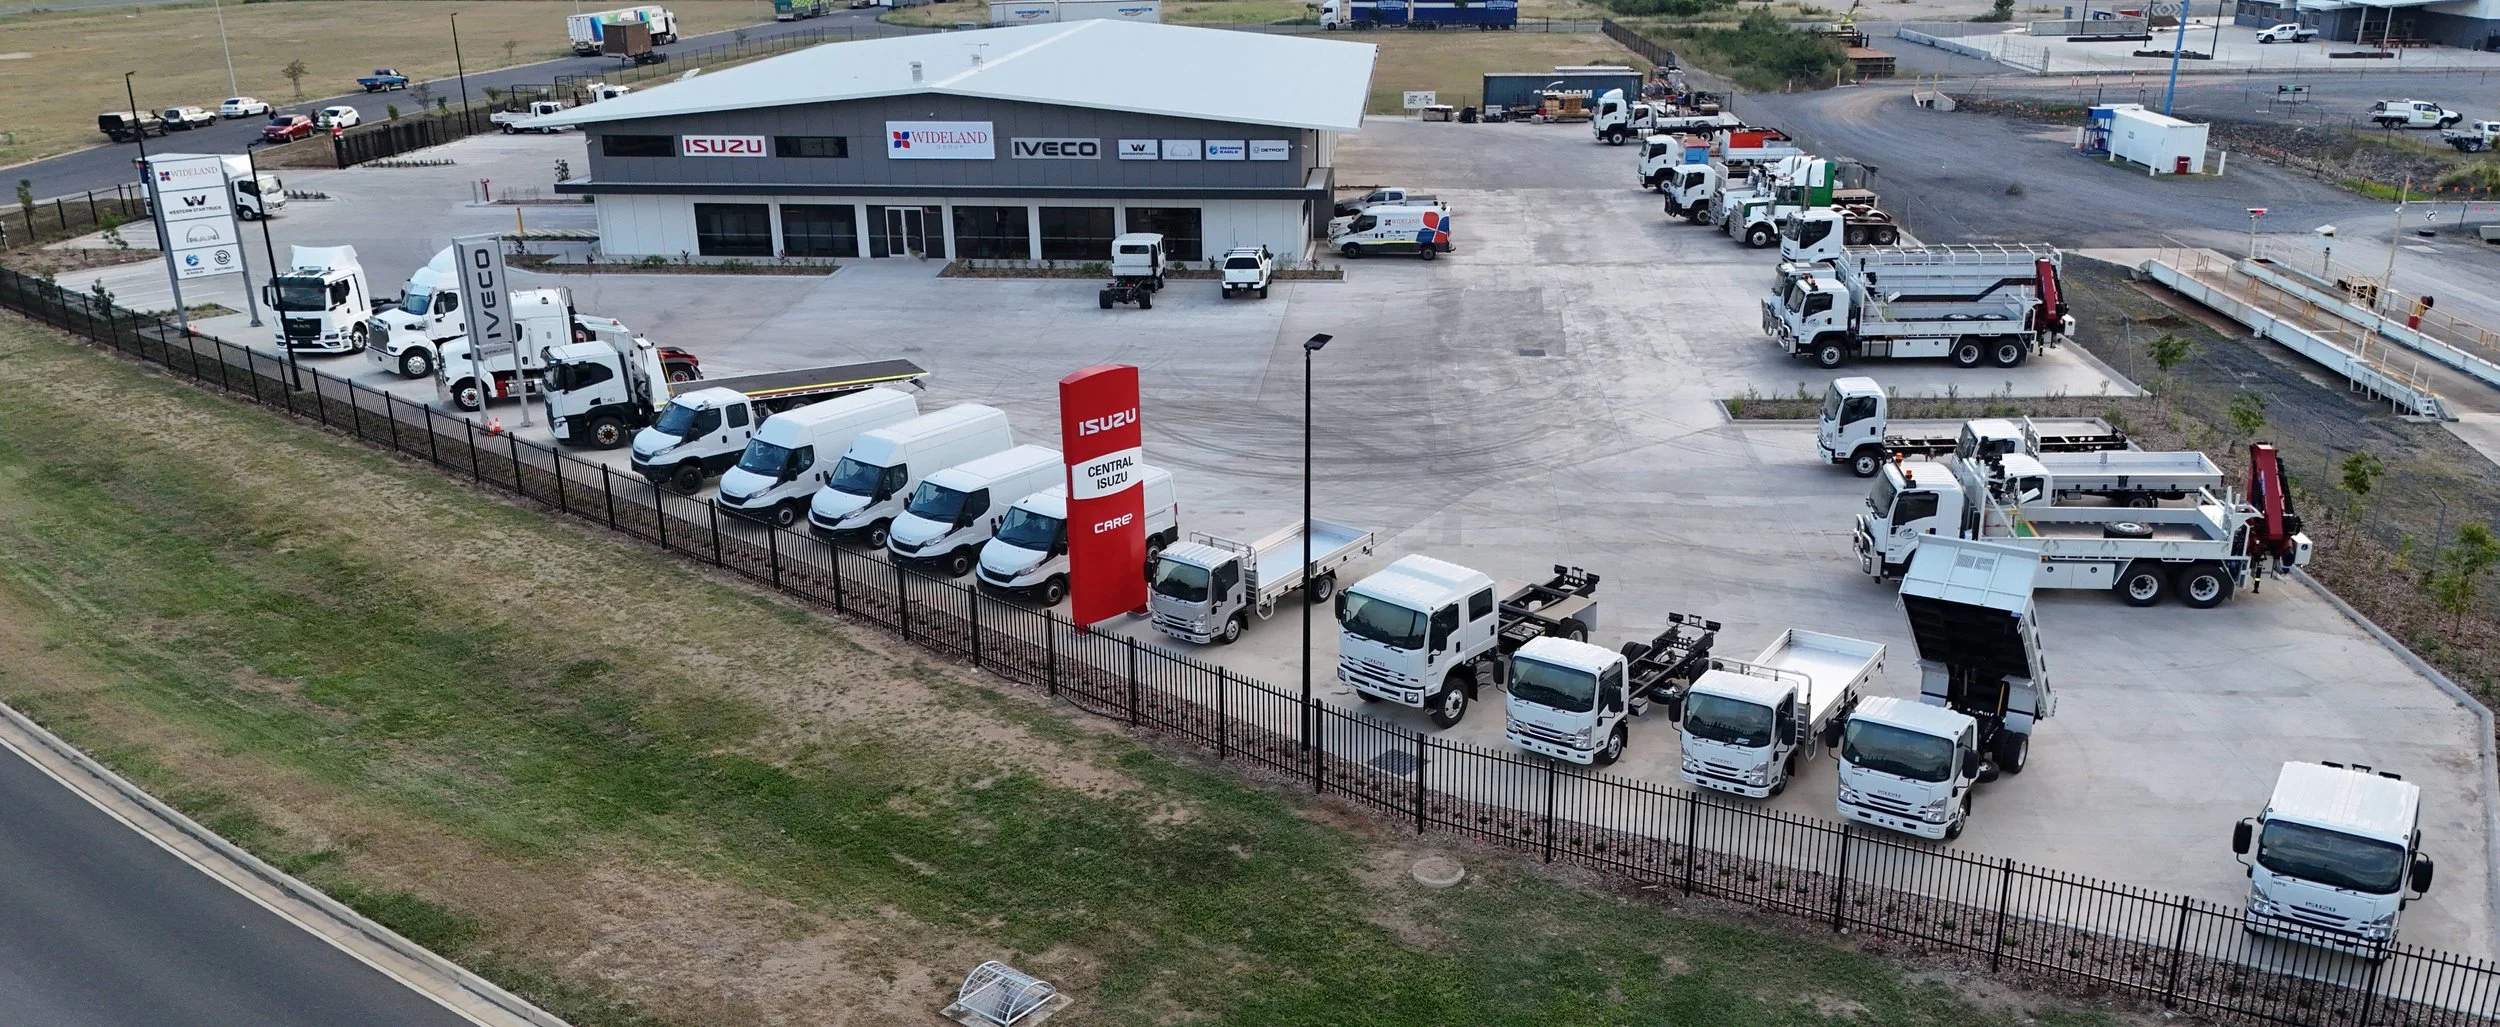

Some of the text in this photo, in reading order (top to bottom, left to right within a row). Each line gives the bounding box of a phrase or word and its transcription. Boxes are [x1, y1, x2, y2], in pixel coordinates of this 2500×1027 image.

[910, 130, 987, 145] WIDELAND
[686, 139, 762, 154] ISUZU
[1014, 141, 1097, 157] IVECO
[170, 166, 218, 177] WIDELAND
[474, 248, 502, 340] IVECO
[1078, 407, 1137, 437] ISUZU
[1087, 455, 1134, 478] CENTRAL
[1096, 470, 1129, 490] ISUZU
[2305, 901, 2336, 912] ISUZU
